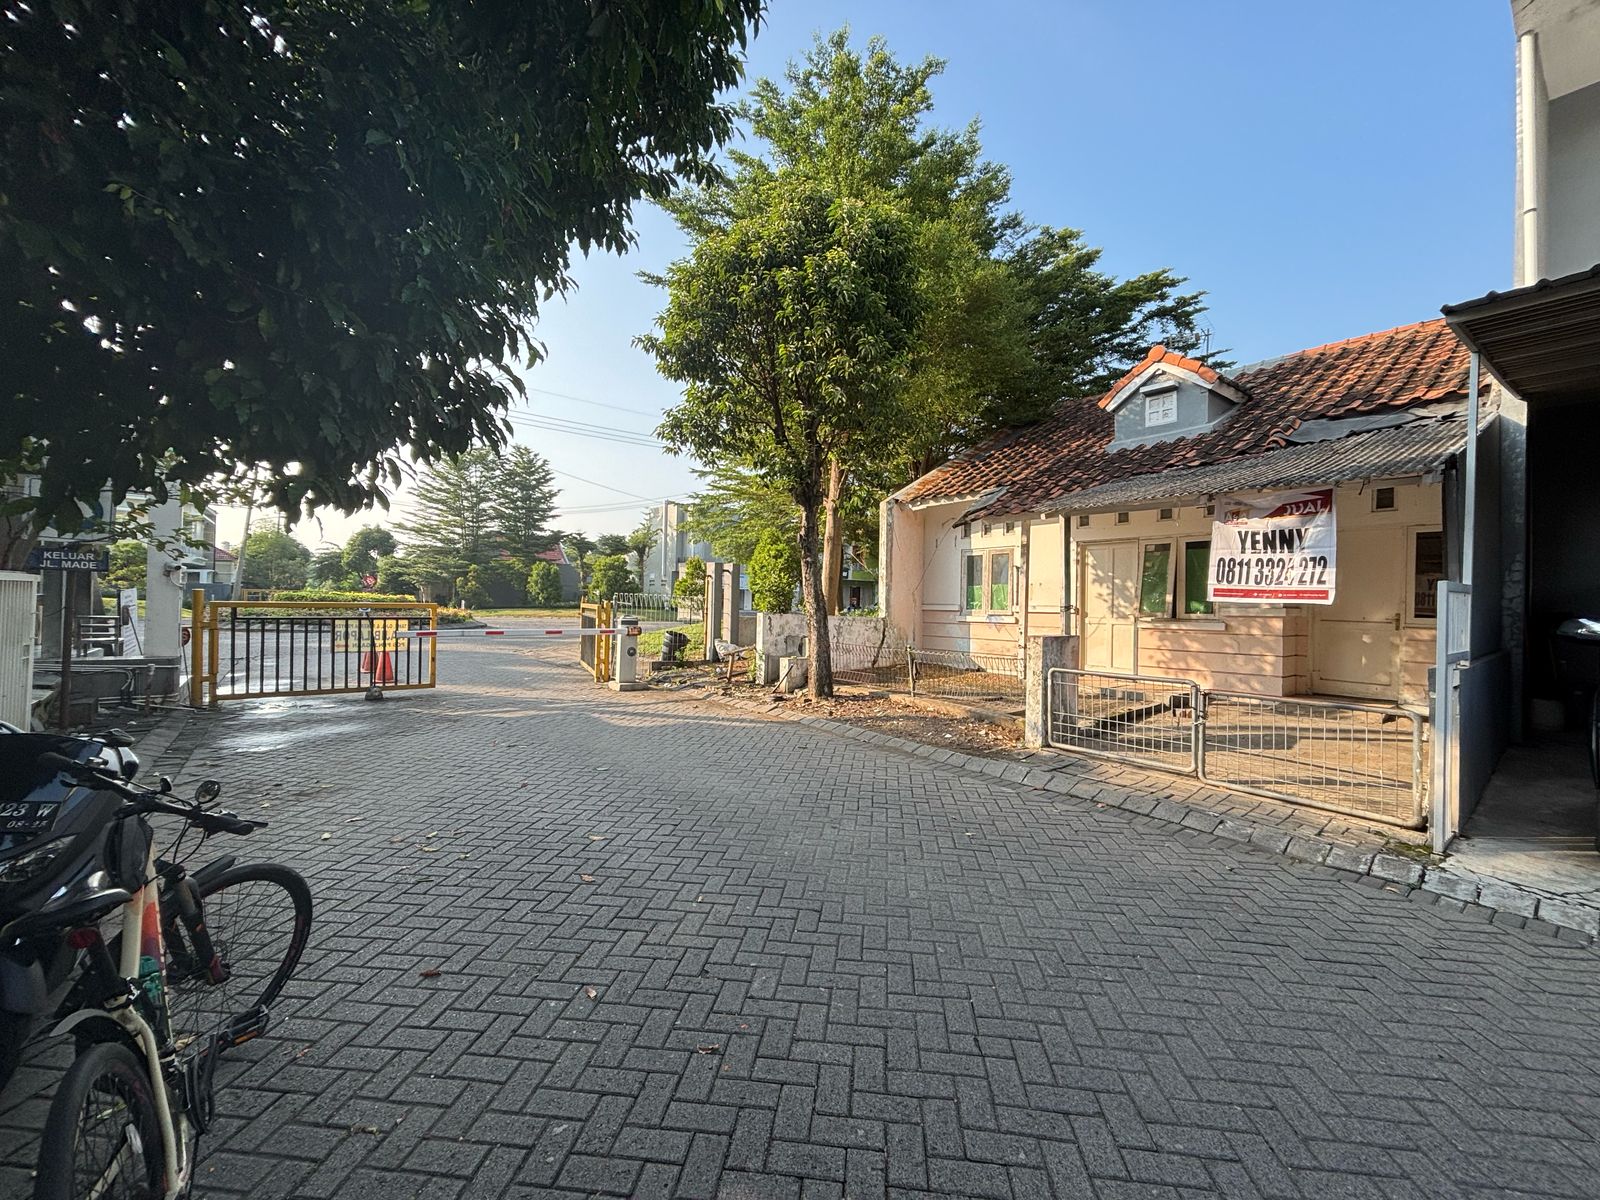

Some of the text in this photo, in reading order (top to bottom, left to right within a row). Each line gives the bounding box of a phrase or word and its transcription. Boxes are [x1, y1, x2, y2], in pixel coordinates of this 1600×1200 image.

[1237, 528, 1310, 554] YENNY
[43, 551, 95, 560] KELUAR
[61, 560, 97, 569] MADE
[1216, 557, 1251, 585] 0811
[1297, 555, 1328, 586] 272
[36, 803, 58, 817] W
